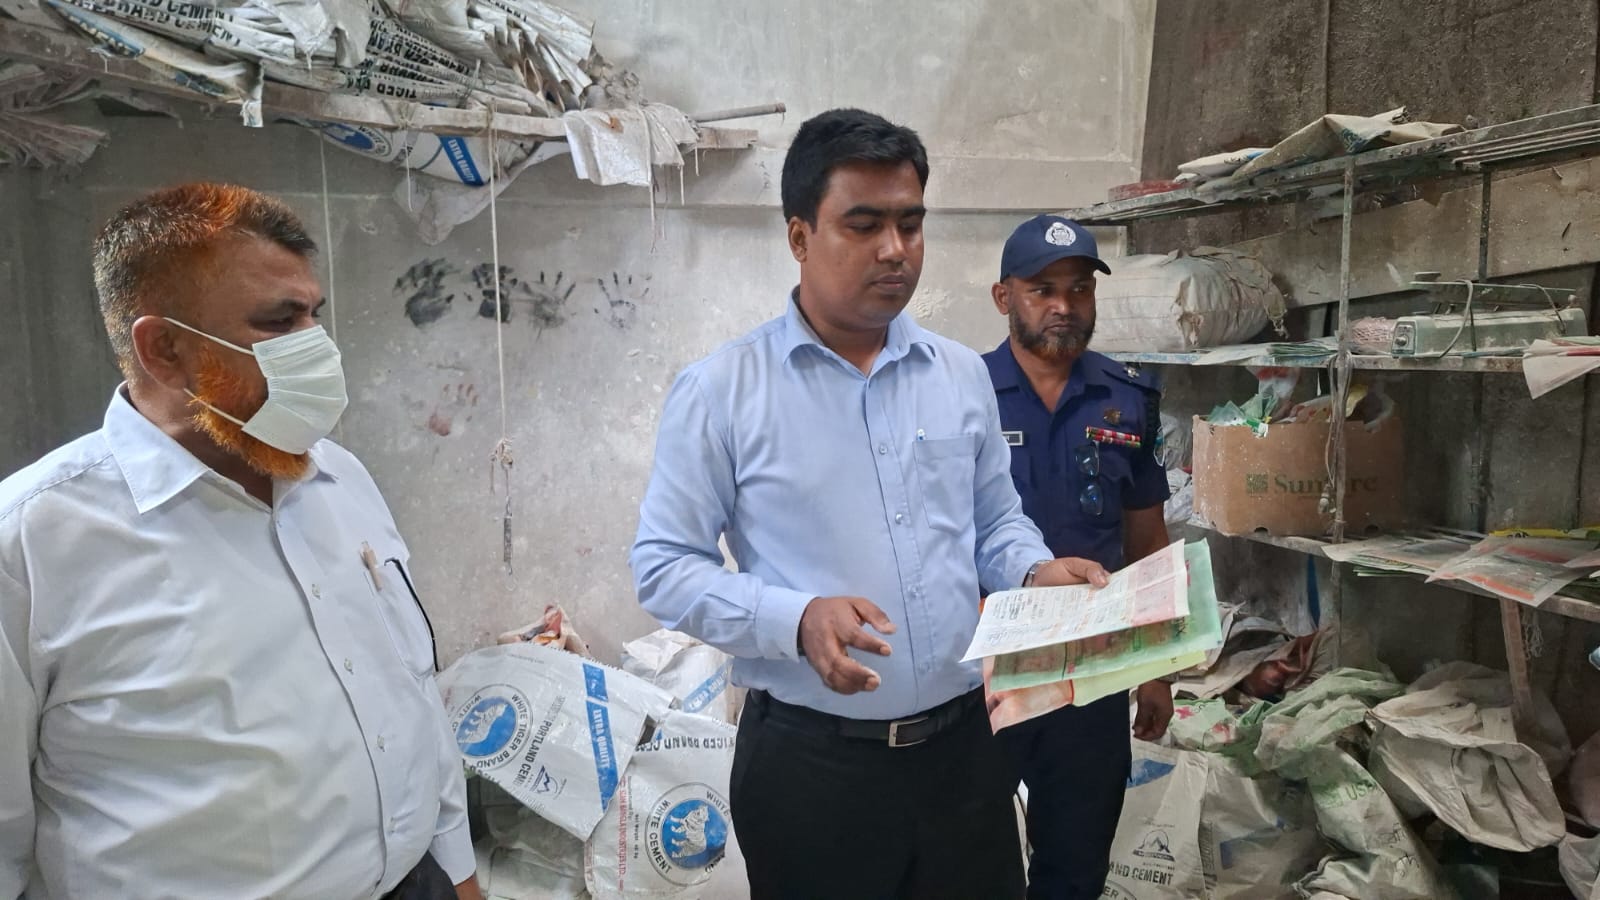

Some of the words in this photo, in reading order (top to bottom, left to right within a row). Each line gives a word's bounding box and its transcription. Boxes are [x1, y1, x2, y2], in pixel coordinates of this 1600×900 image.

[511, 694, 528, 720] WHITE
[510, 722, 528, 751] TIGER
[525, 719, 552, 763] PORTLAND
[476, 750, 510, 769] BRAND
[650, 799, 672, 830] WHITE
[706, 790, 731, 817] WHITE
[649, 832, 673, 874] CEMENT
[1131, 866, 1174, 886] CEMENT
